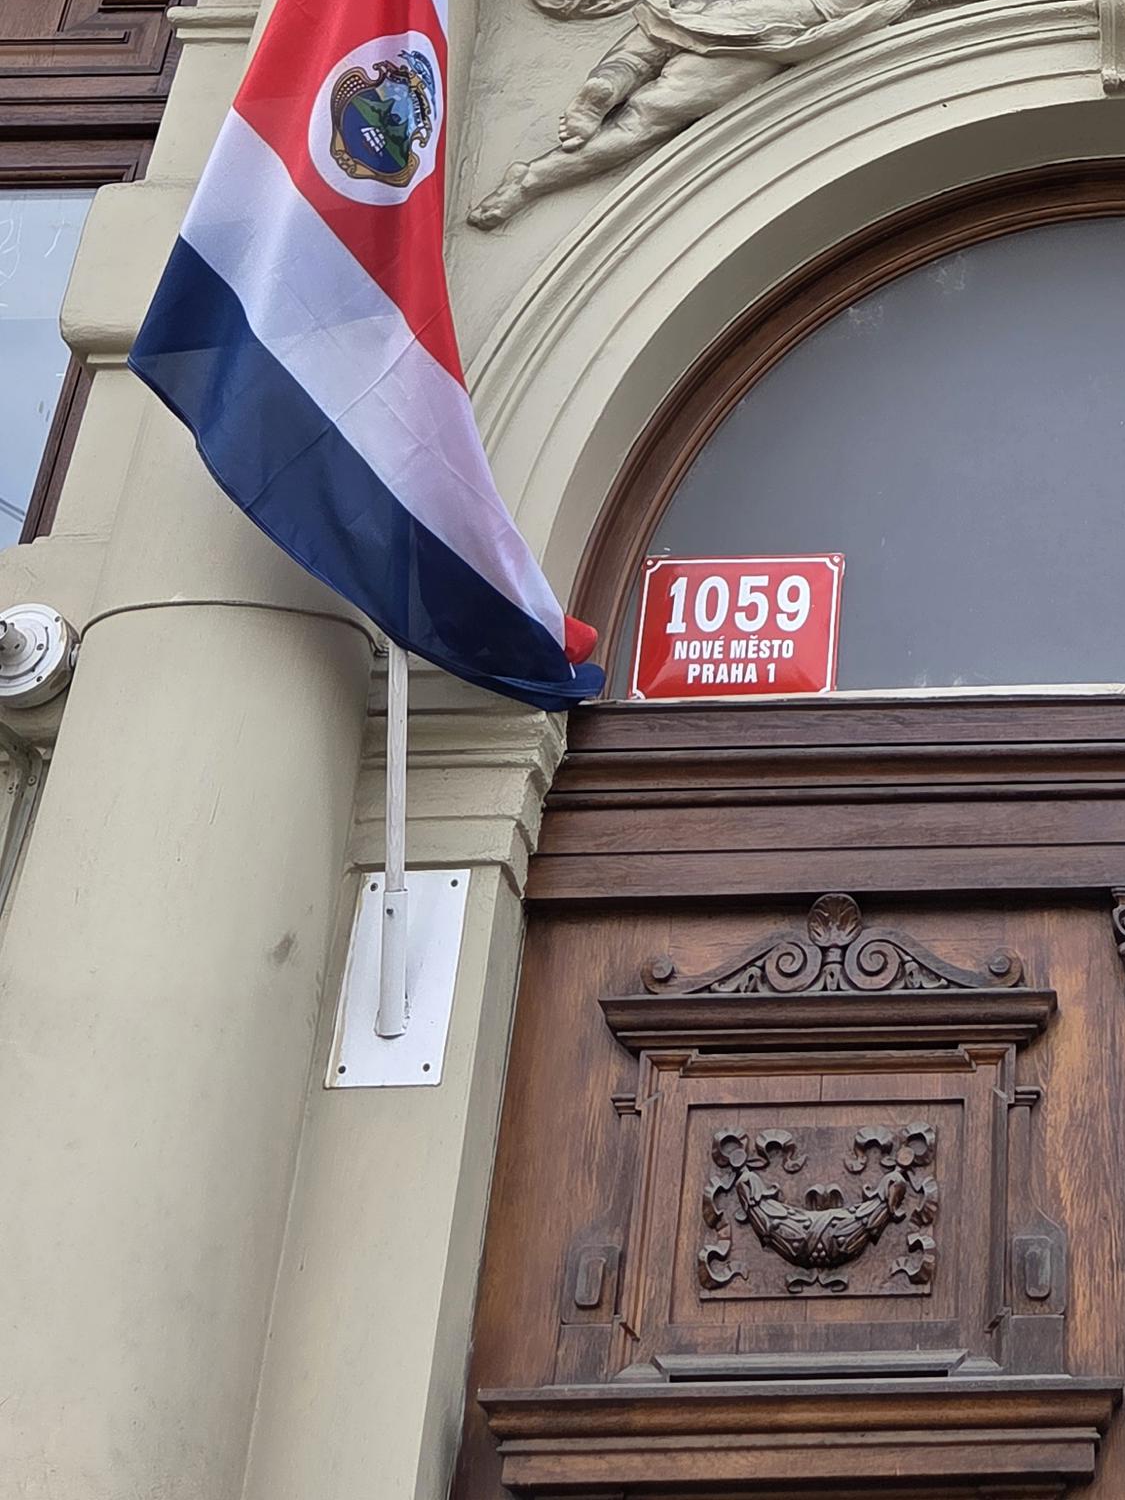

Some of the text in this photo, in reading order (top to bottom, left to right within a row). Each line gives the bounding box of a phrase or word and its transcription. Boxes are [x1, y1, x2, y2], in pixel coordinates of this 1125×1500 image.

[666, 575, 810, 633] 1059
[674, 635, 794, 660] NOVÉ MĚSTO
[687, 662, 776, 684] PRAHA 1
